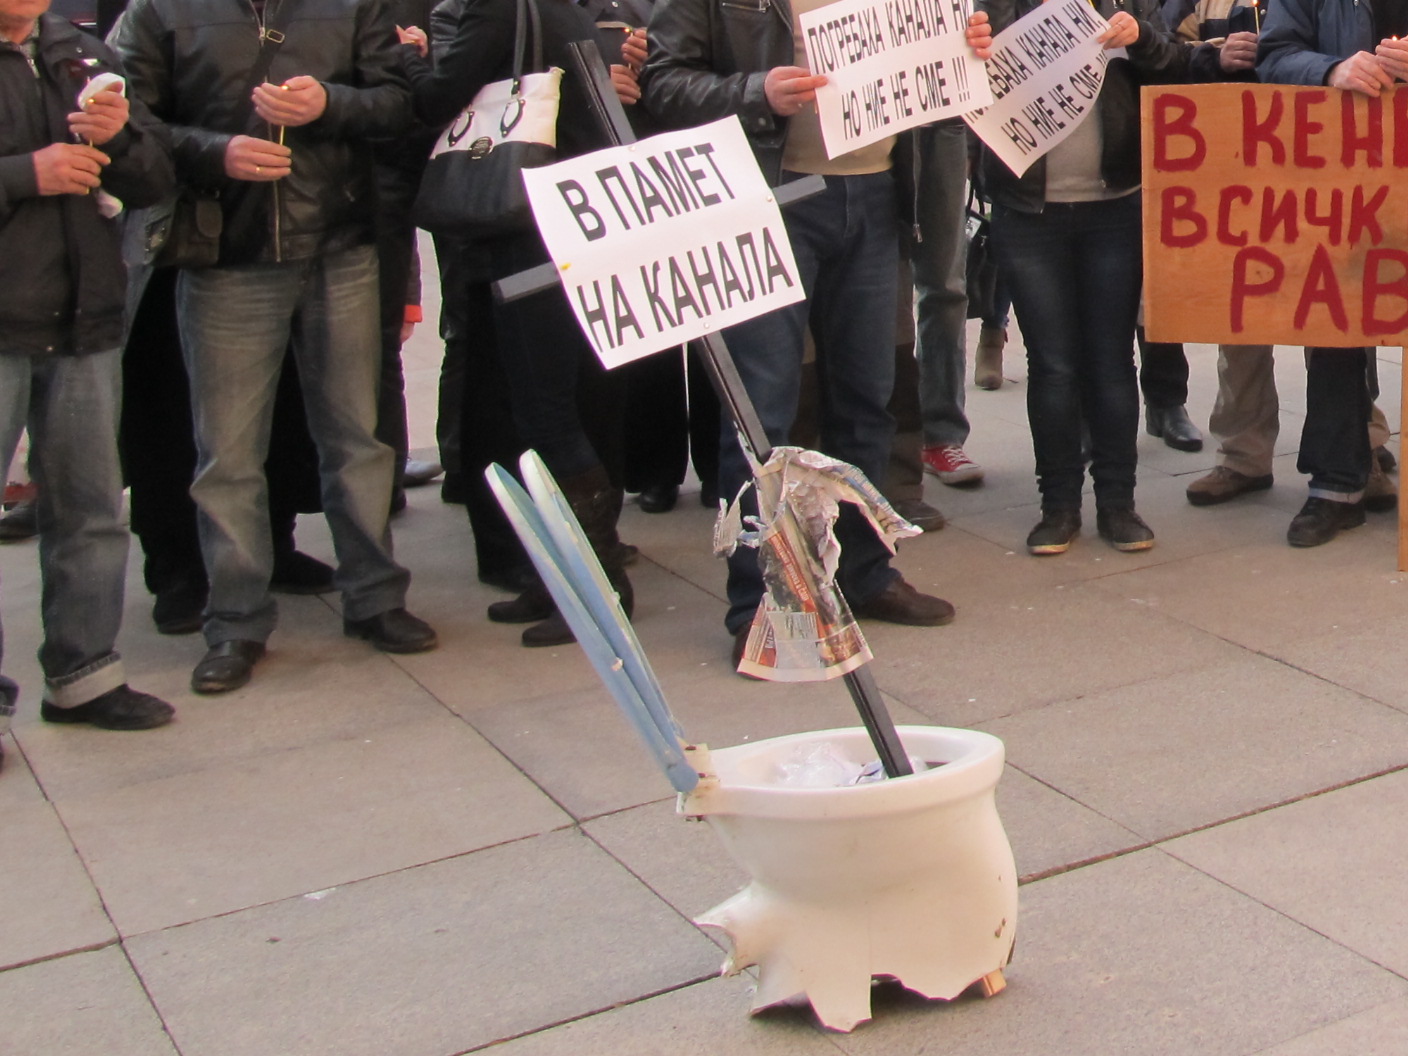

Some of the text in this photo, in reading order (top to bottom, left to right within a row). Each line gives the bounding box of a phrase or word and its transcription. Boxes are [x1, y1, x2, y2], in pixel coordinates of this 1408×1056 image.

[807, 6, 886, 75] ПОГРЕБАХА
[1015, 14, 1082, 71] КАНАЛА
[841, 56, 971, 141] НО НИЕ НЕ СМЕ !!!
[1000, 117, 1038, 156] НО
[1021, 96, 1067, 140] НИЕ
[1048, 83, 1085, 121] НЕ
[1069, 63, 1104, 100] СМЕ
[1153, 92, 1207, 172] В
[556, 142, 736, 242] В ПАМЕТ
[576, 226, 795, 353] НА КАНАЛА
